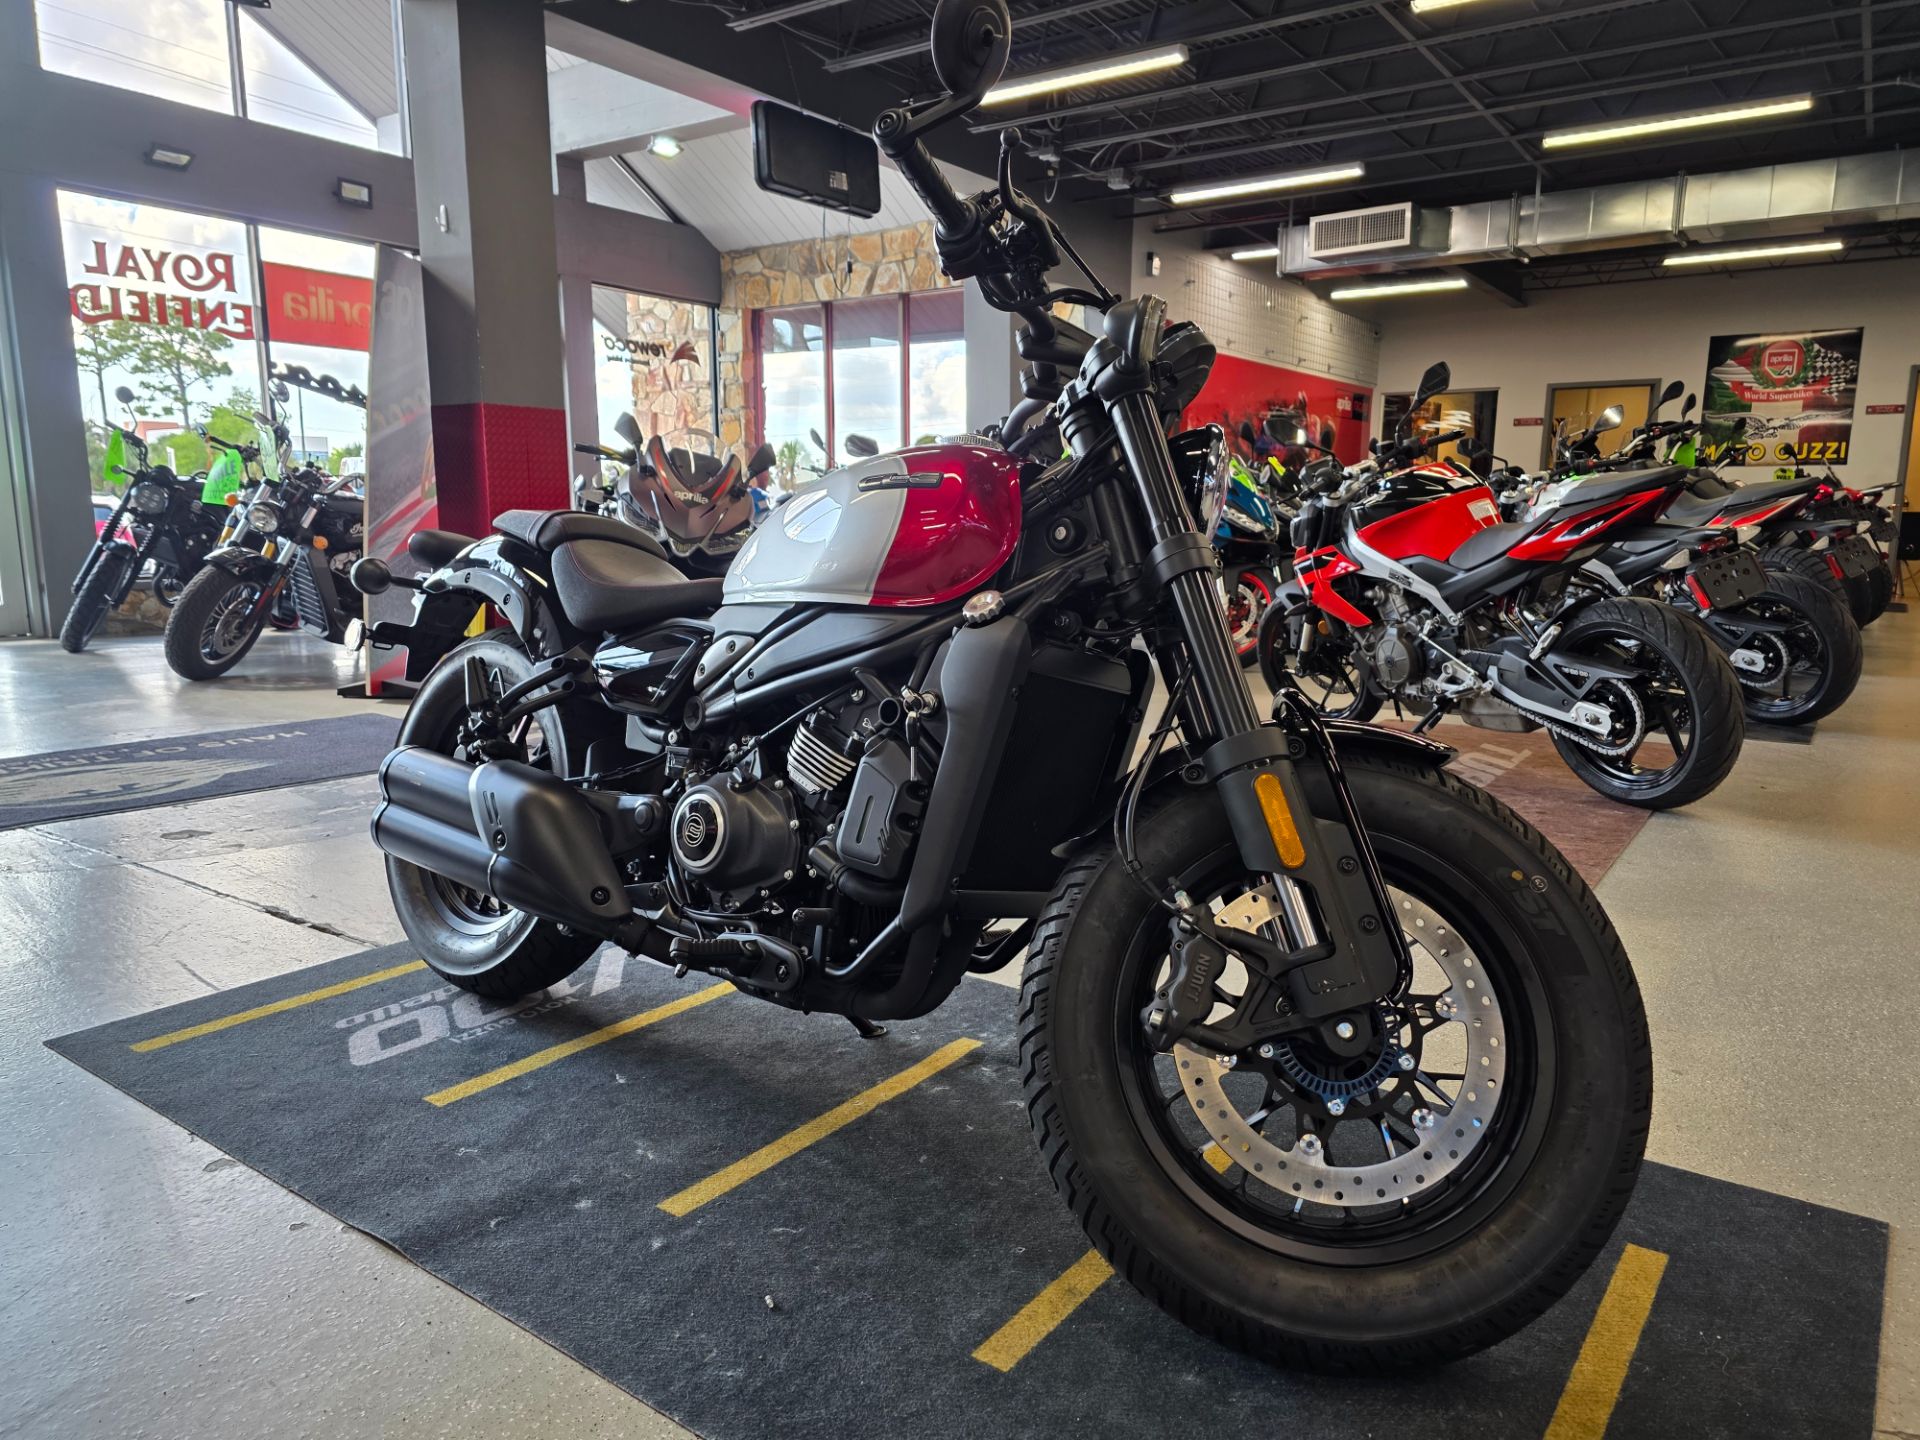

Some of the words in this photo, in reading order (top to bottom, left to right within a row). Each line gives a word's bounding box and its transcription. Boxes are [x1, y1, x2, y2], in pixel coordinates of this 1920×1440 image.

[1744, 391, 1768, 401] World
[1768, 388, 1814, 401] Superbikes
[673, 490, 709, 504] aprilia
[198, 731, 308, 748] HAUS
[132, 746, 187, 757] OF
[518, 995, 579, 1018] MOTO
[448, 1018, 517, 1044] GUZZI
